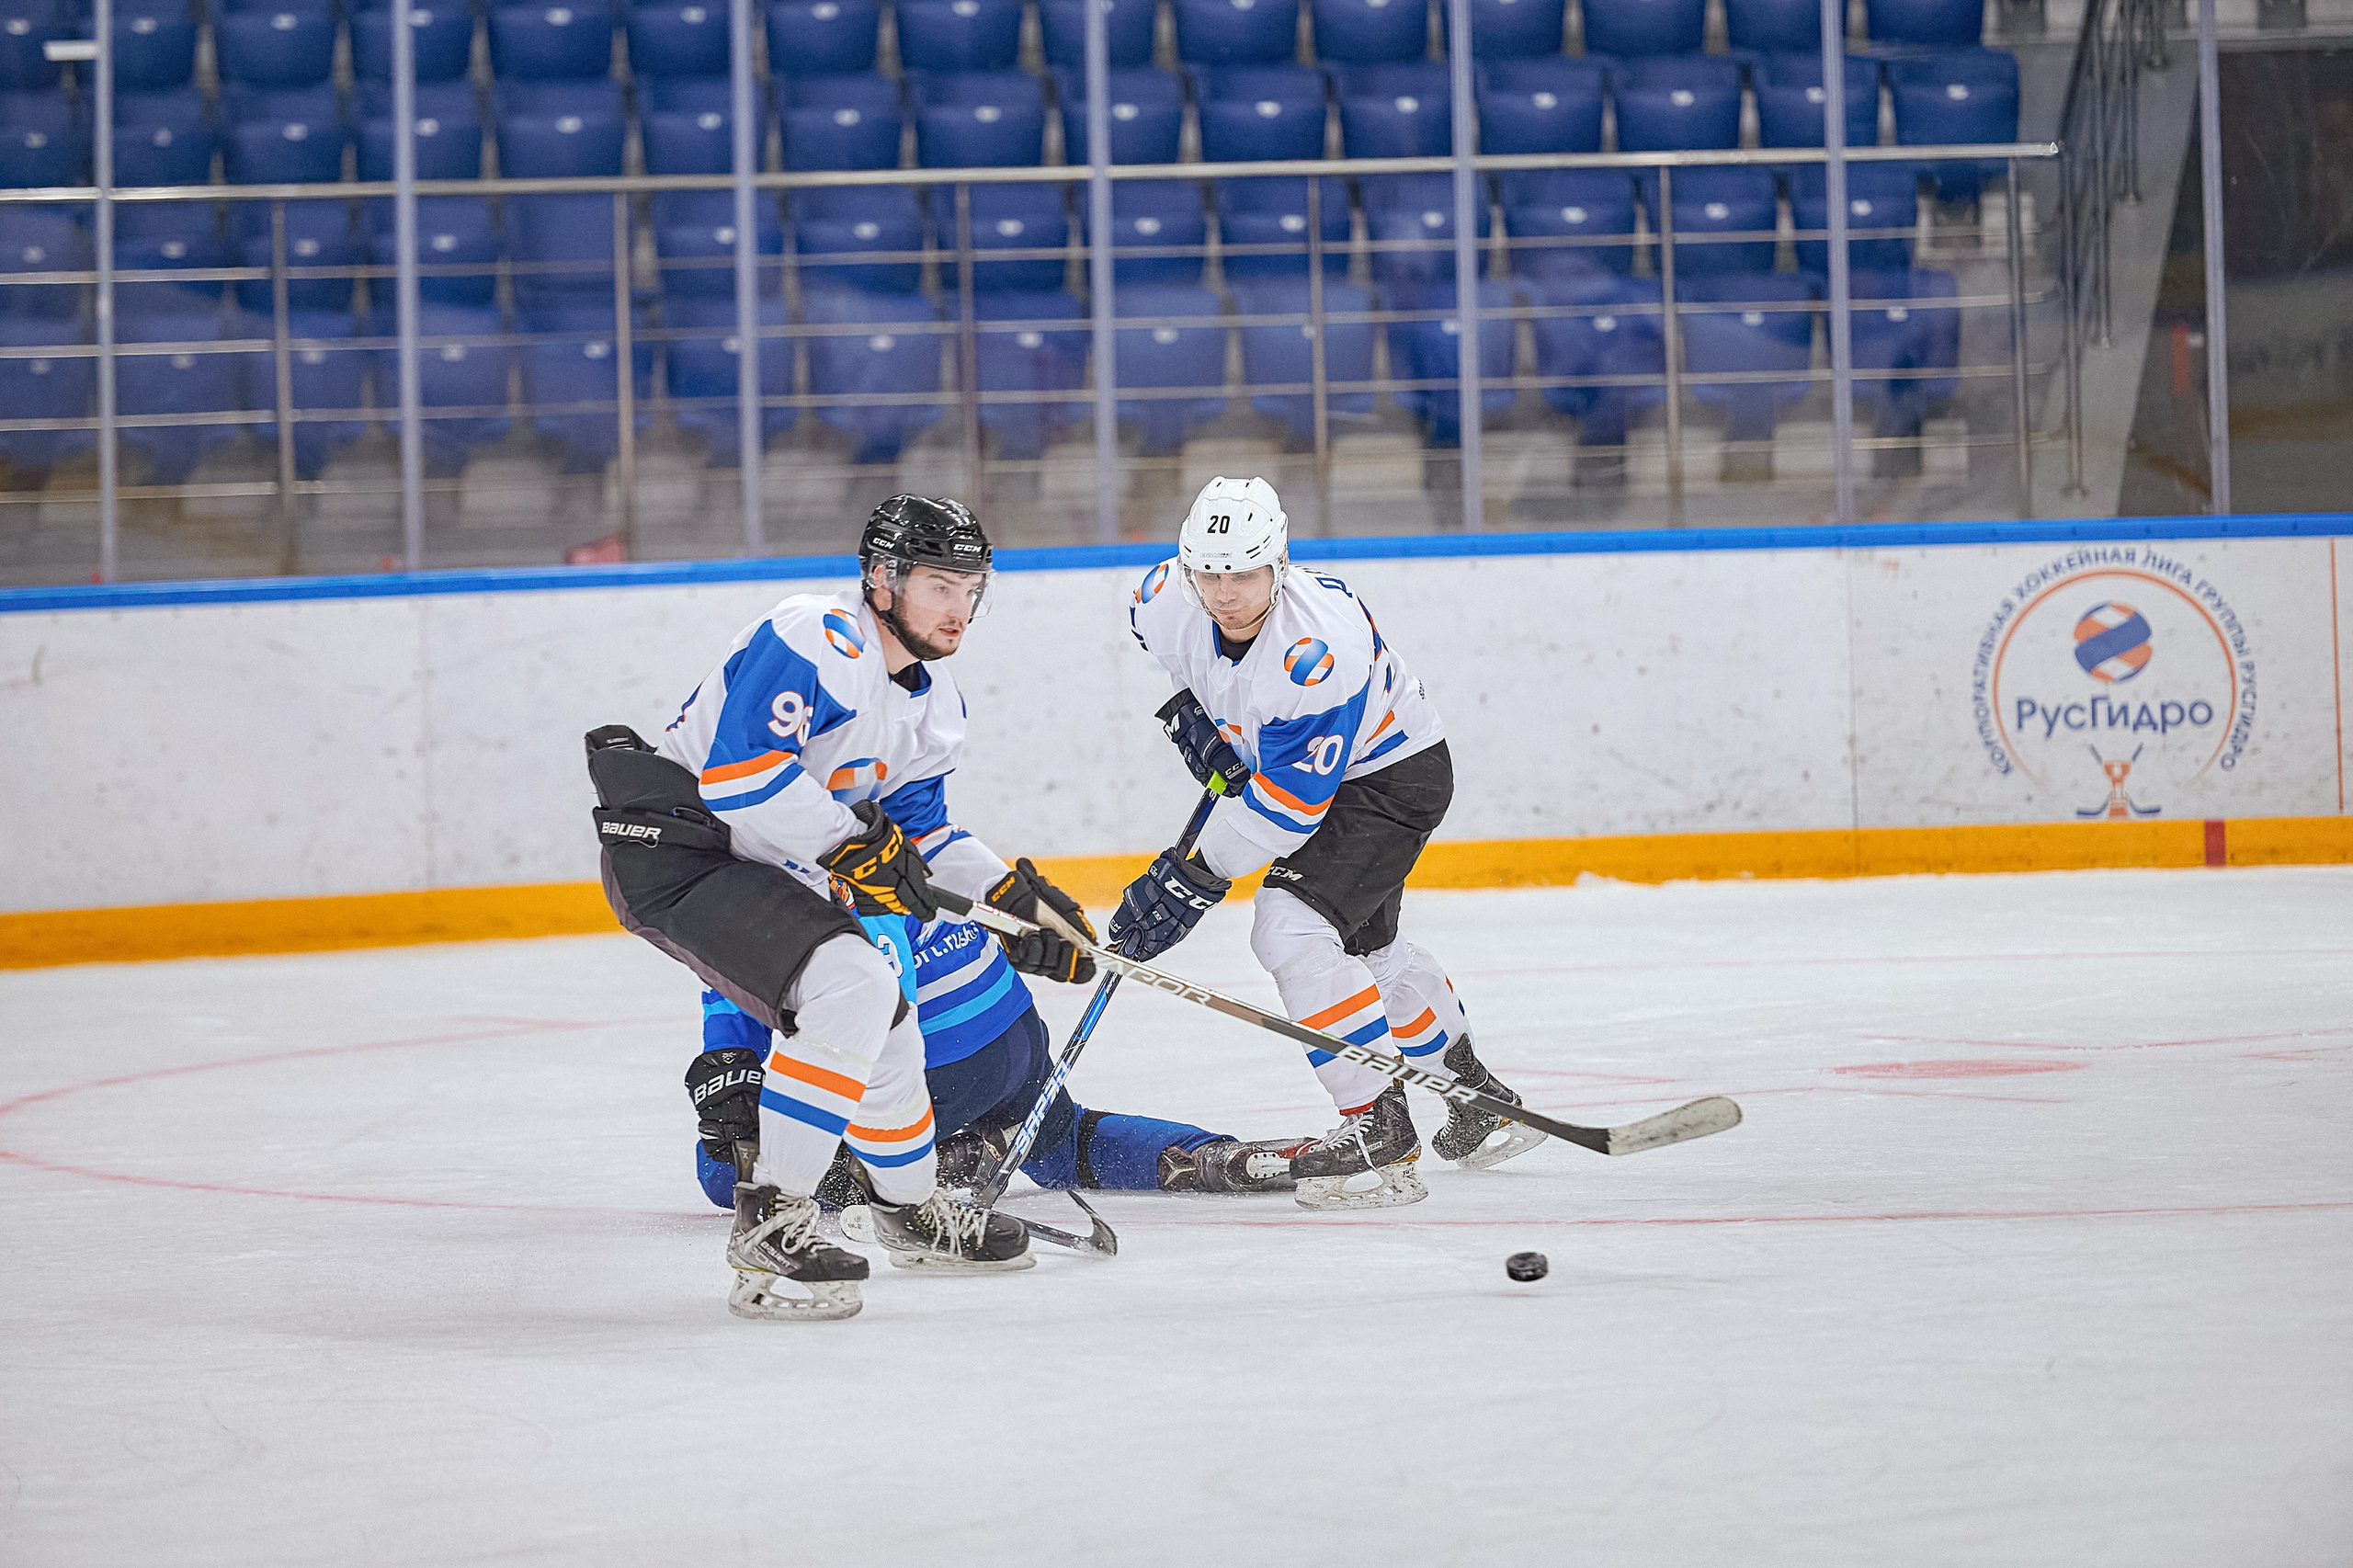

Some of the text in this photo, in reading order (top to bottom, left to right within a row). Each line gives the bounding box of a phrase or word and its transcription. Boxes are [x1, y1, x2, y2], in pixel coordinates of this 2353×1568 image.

[1207, 515, 1231, 534] 20
[872, 537, 895, 550] CCM
[953, 543, 983, 552] CCM
[2016, 546, 2137, 601] ХОККЕЙНАЯ
[2142, 549, 2194, 586] ЛИГА
[2016, 695, 2213, 739] РусГидро
[1291, 733, 1344, 776] 20
[601, 821, 662, 839] BAUER
[991, 876, 1016, 903] CCM
[1164, 876, 1218, 911] CC
[693, 1069, 766, 1105] BAUE
[1335, 1045, 1479, 1104] BAUER
